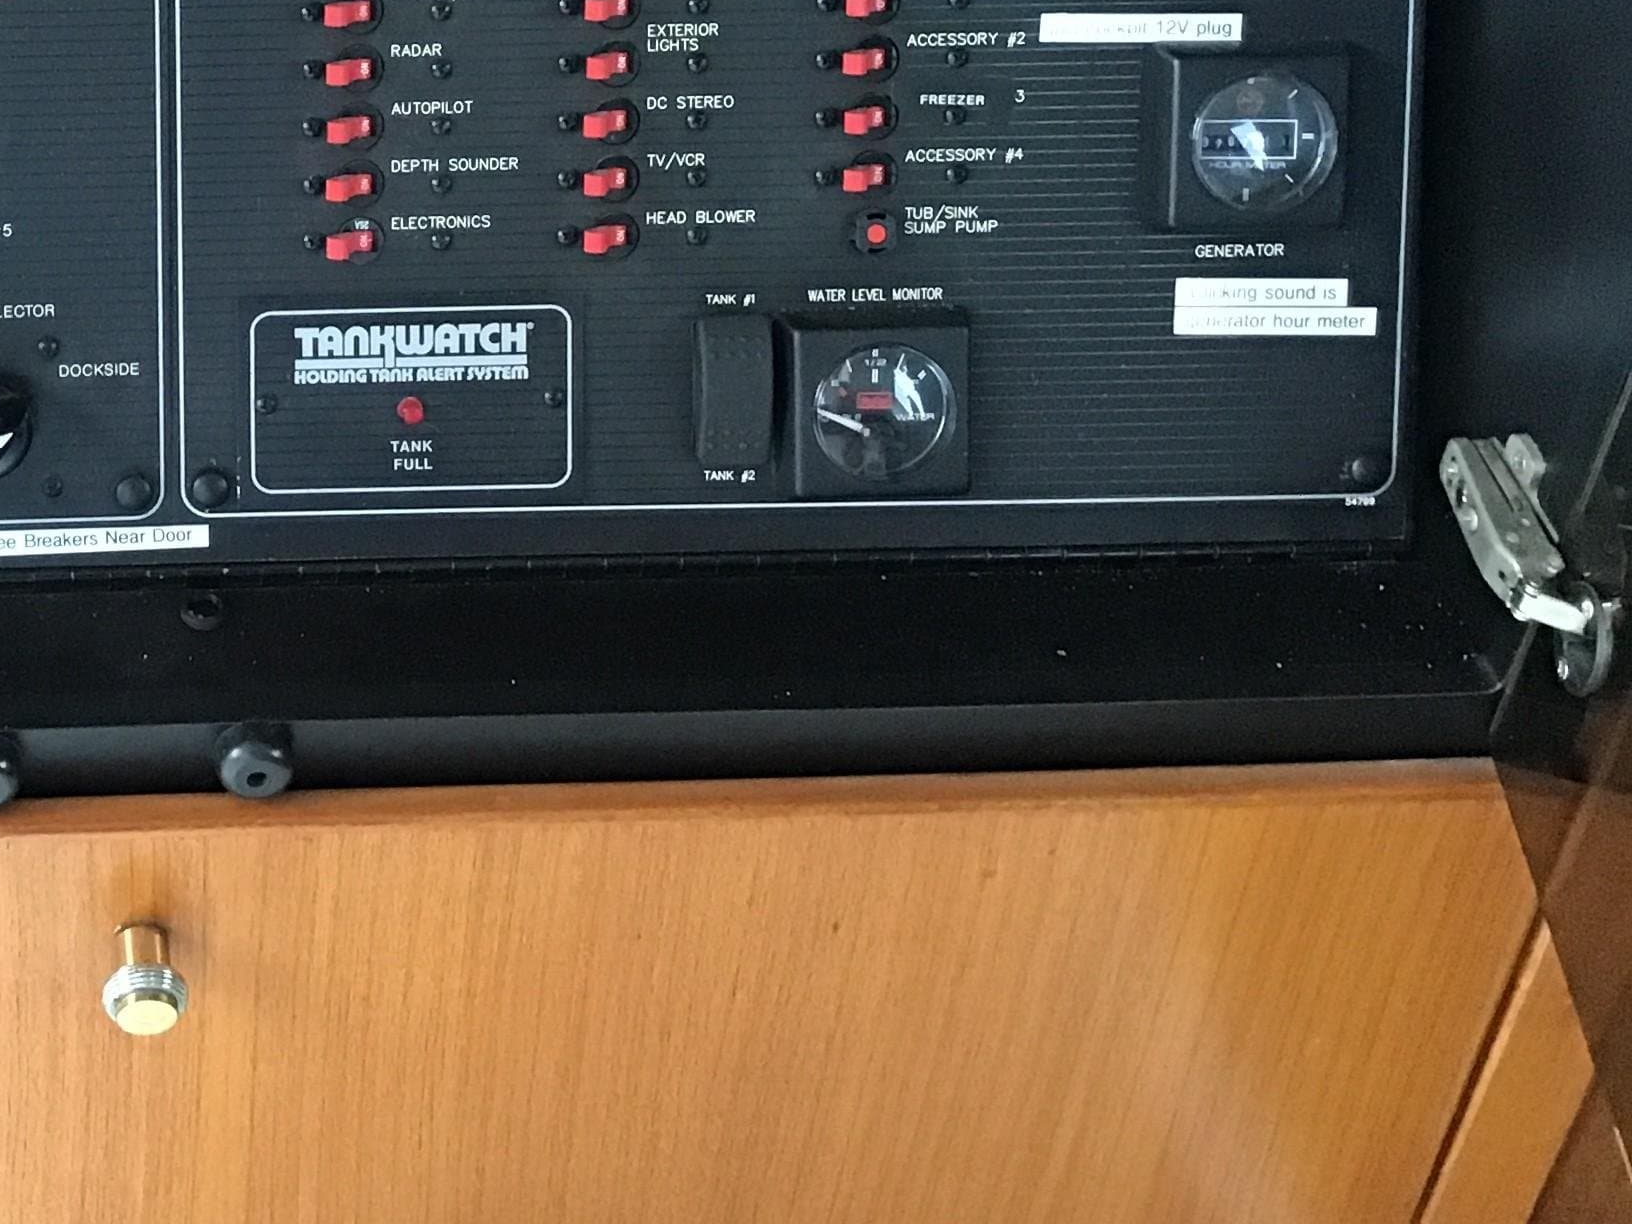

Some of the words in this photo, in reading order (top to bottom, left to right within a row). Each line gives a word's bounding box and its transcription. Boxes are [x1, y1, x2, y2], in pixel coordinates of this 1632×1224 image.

[648, 23, 718, 37] EXTERIOR
[391, 44, 442, 57] RADAR
[648, 38, 698, 52] LIGHTS
[392, 101, 473, 115] AUTOPILOT
[647, 152, 704, 170] TV/VCR
[392, 215, 490, 230] ELECTRONICS
[1195, 244, 1284, 258] GENERATOR
[808, 289, 849, 302] WATER
[852, 288, 886, 301] LEVEL
[893, 287, 943, 300] MONITOR
[295, 322, 527, 358] TANKWATCH
[59, 363, 139, 377] DOCKSIDE
[295, 368, 367, 384] HOLDING
[369, 367, 413, 382] TANK
[417, 367, 464, 381] ALERT
[467, 366, 528, 380] SYSTEM
[25, 534, 97, 546] Breakers
[106, 532, 143, 543] Near
[154, 530, 190, 541] Door
